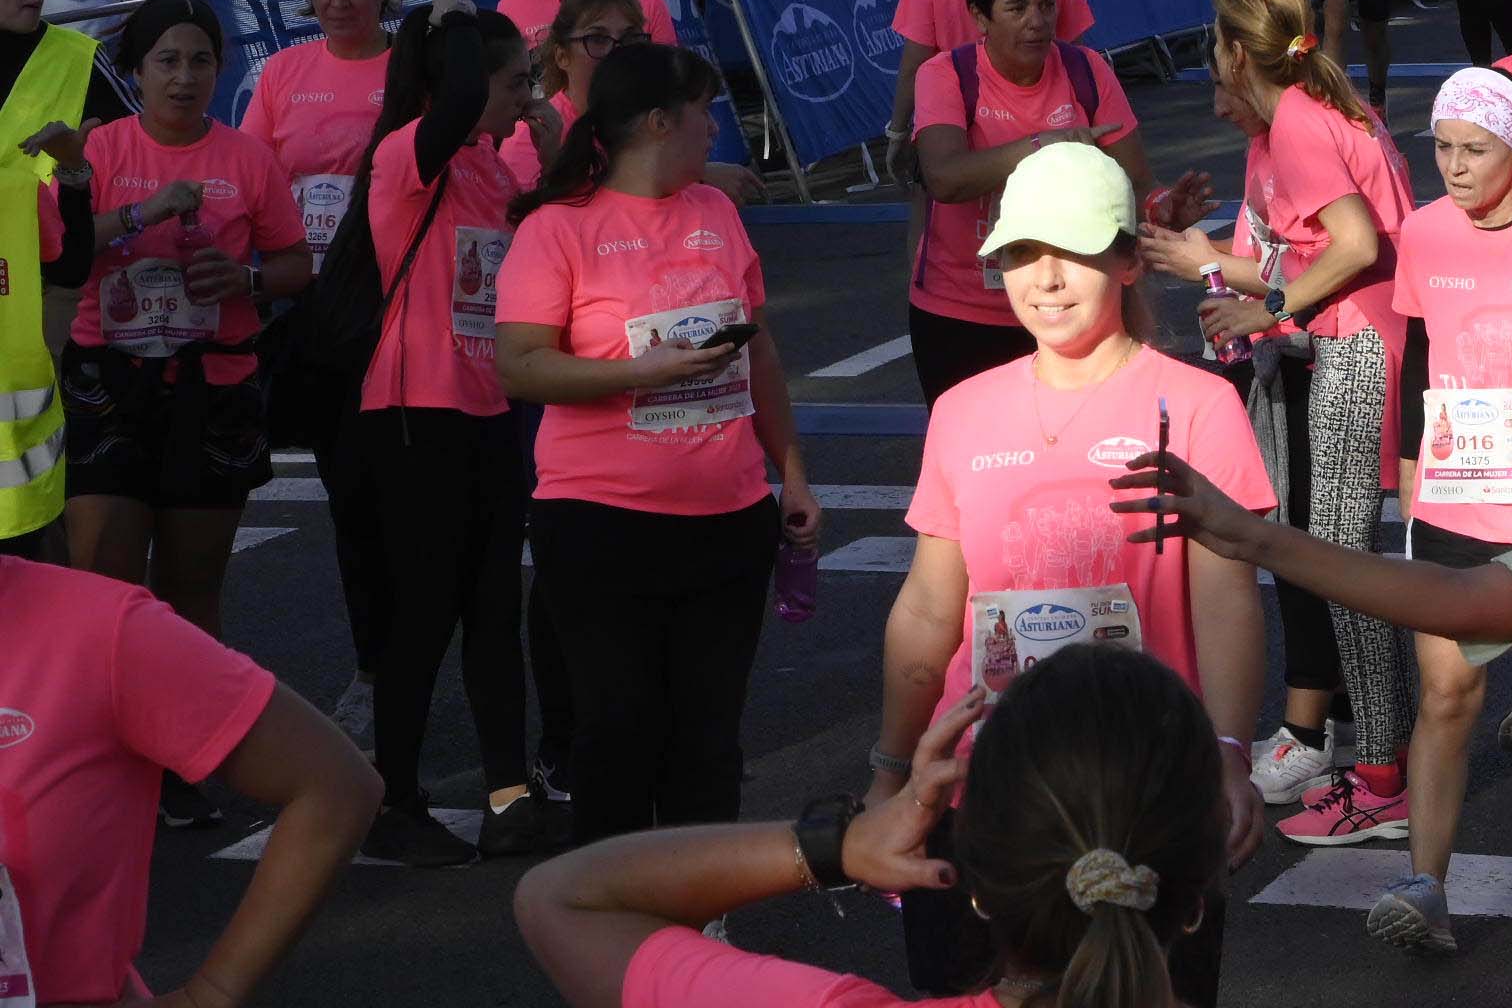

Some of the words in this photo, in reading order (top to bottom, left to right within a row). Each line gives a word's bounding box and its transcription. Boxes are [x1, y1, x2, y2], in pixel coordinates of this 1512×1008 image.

[781, 42, 850, 85] ASTURIANA
[291, 92, 335, 104] OYSHO
[113, 176, 159, 190] OYSHO
[304, 213, 336, 228] 016
[307, 232, 328, 241] 3265
[1429, 275, 1476, 291] OYSHO
[141, 296, 179, 312] 016
[672, 326, 715, 340] ASTURIANA
[647, 391, 684, 403] CARRERA
[684, 391, 696, 400] DE
[696, 390, 708, 398] LA
[645, 408, 686, 422] OYSHO
[1456, 435, 1494, 450] 016
[971, 450, 1035, 472] OYSHO
[1460, 456, 1490, 466] 14375
[1434, 470, 1462, 478] CARRERA
[1463, 470, 1473, 478] DE
[1473, 470, 1483, 478] LA
[1431, 486, 1464, 495] OYSHO
[1018, 616, 1081, 633] ASTURIANA
